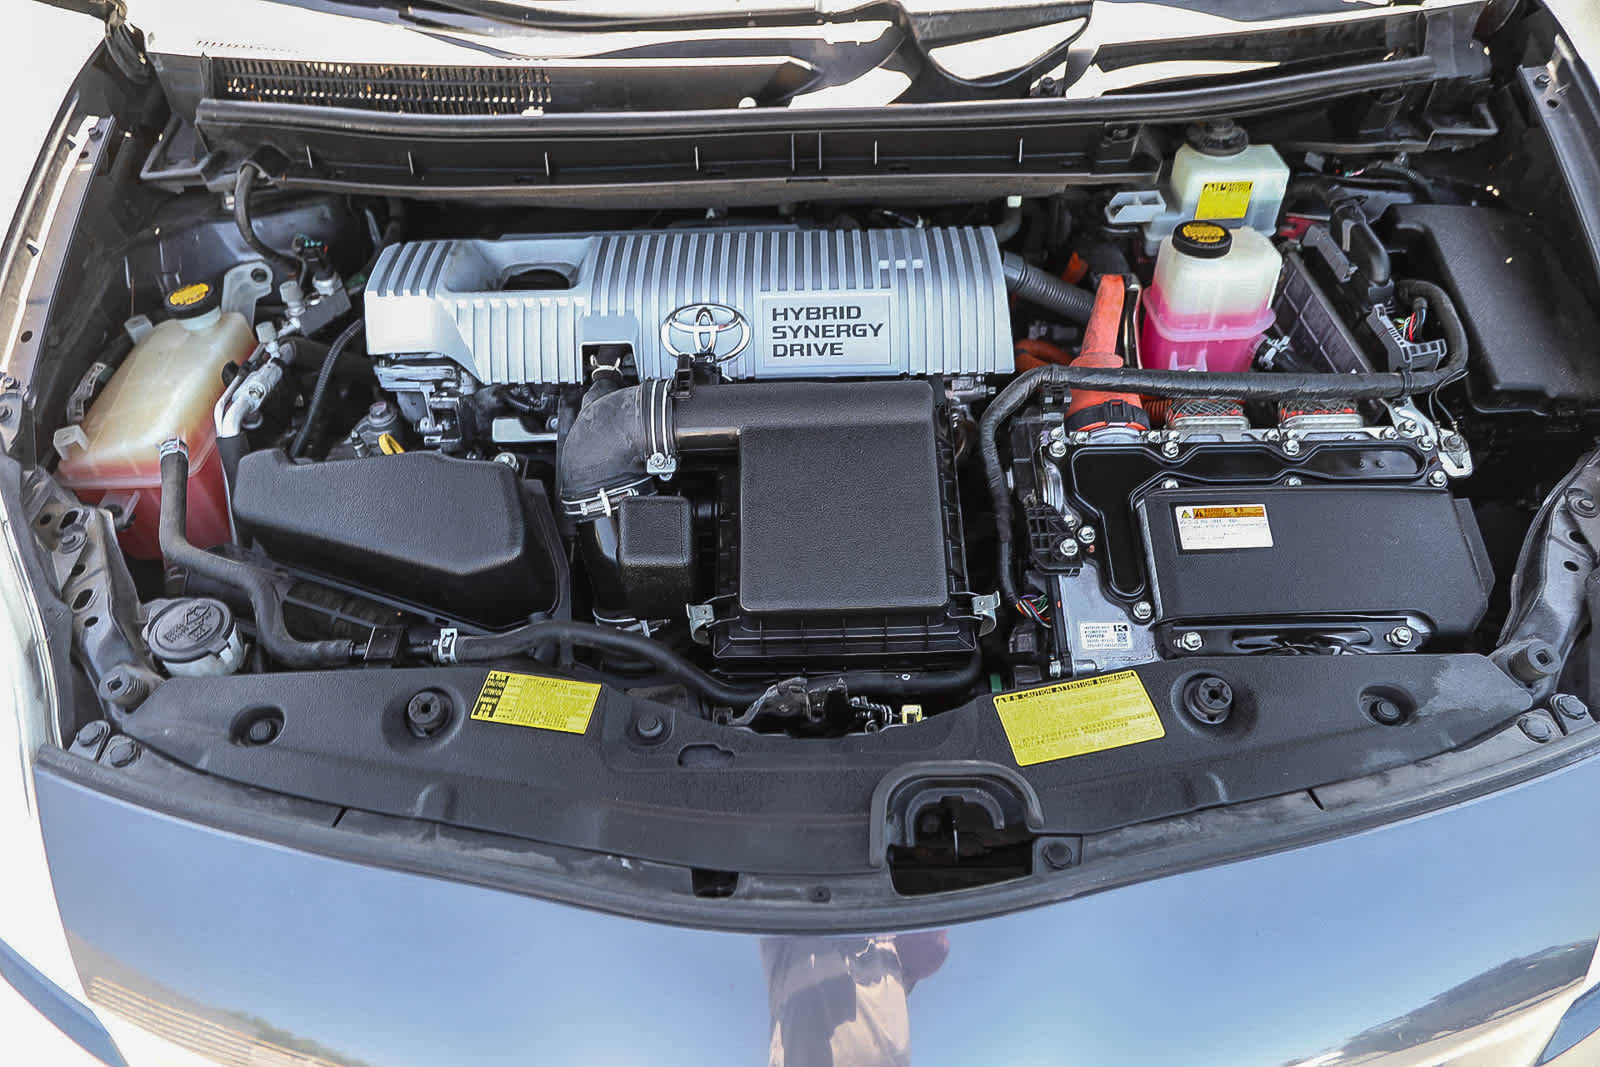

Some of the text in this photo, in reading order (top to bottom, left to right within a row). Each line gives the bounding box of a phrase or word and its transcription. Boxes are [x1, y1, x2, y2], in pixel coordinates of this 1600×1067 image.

[772, 306, 861, 321] HYBRID
[772, 323, 883, 339] SYNERGY
[772, 342, 843, 357] DRIVE
